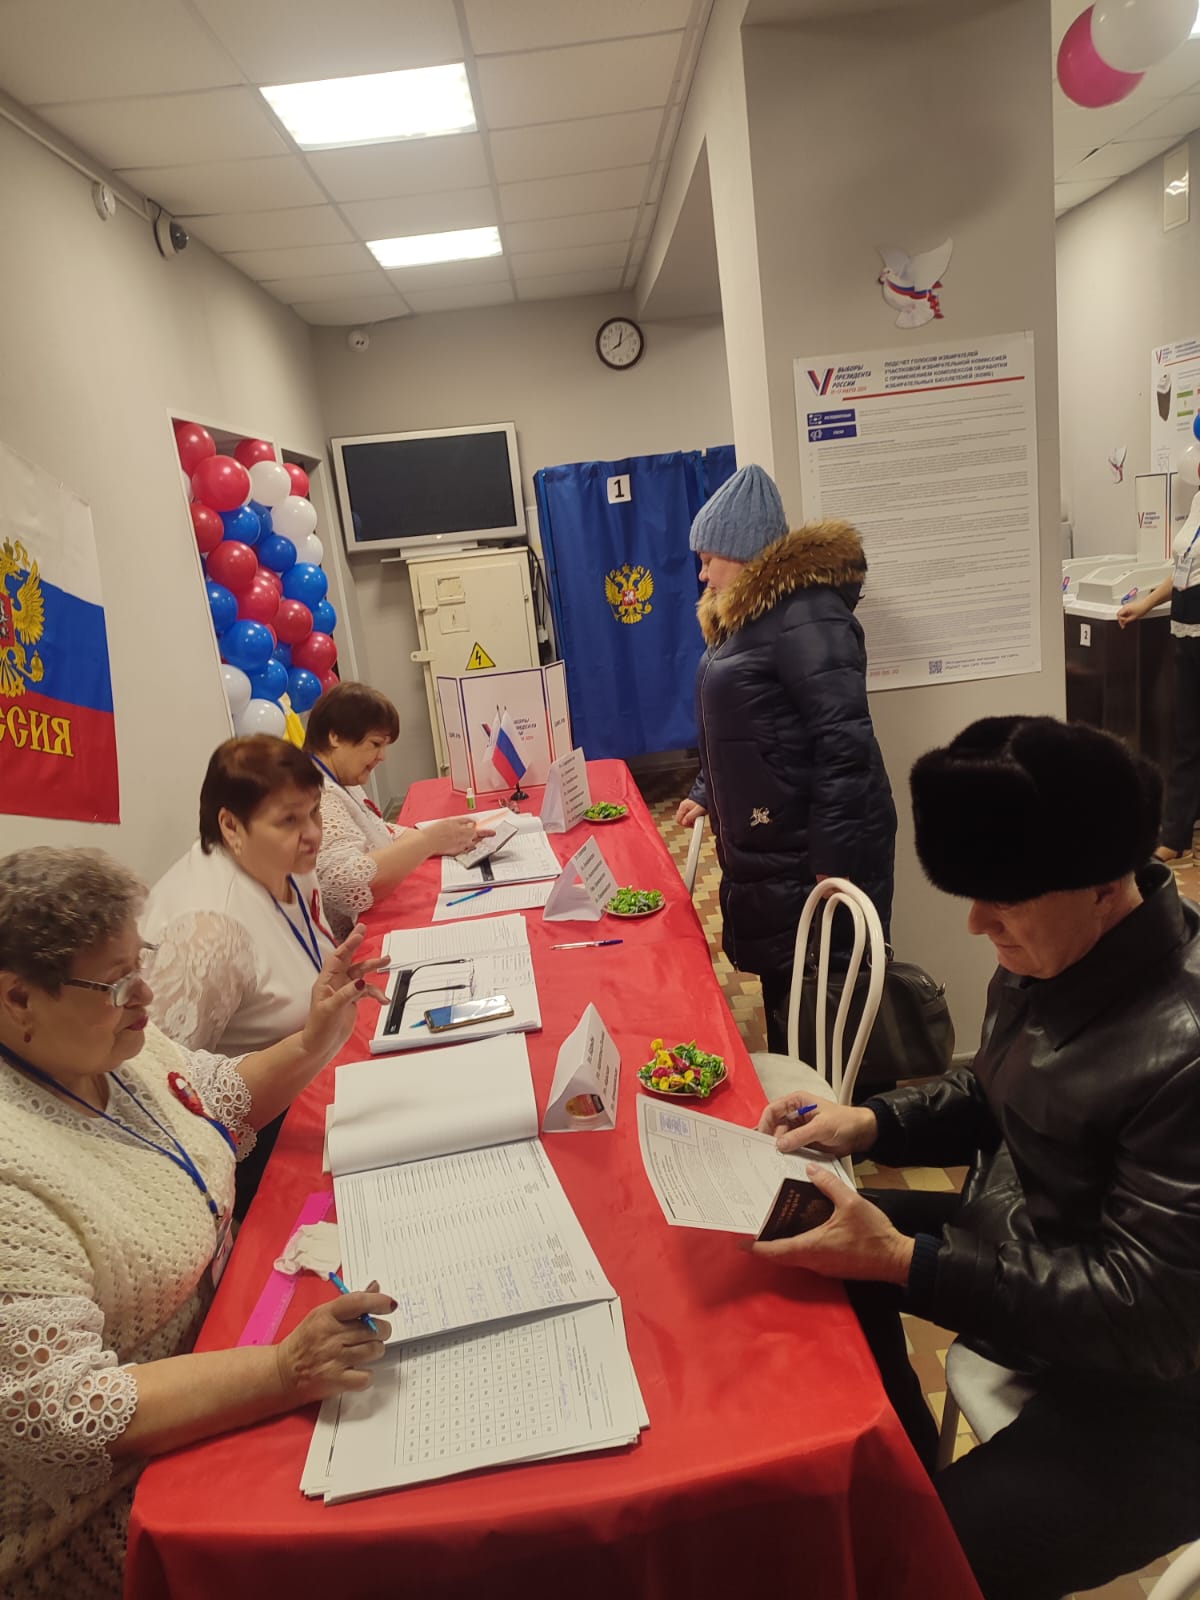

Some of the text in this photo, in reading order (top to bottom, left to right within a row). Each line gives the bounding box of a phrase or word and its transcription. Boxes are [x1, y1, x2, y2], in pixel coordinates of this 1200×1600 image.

[971, 354, 1008, 363] КОМИССИЕЙ
[837, 364, 864, 373] ВЫБОРЫ
[834, 371, 872, 380] ПРЕЗИДЕНТА
[889, 372, 933, 381] ПРИМЕНЕНИЕМ
[832, 380, 856, 388] РОССИИ
[614, 479, 625, 498] 1
[0, 705, 74, 757] СИЯ
